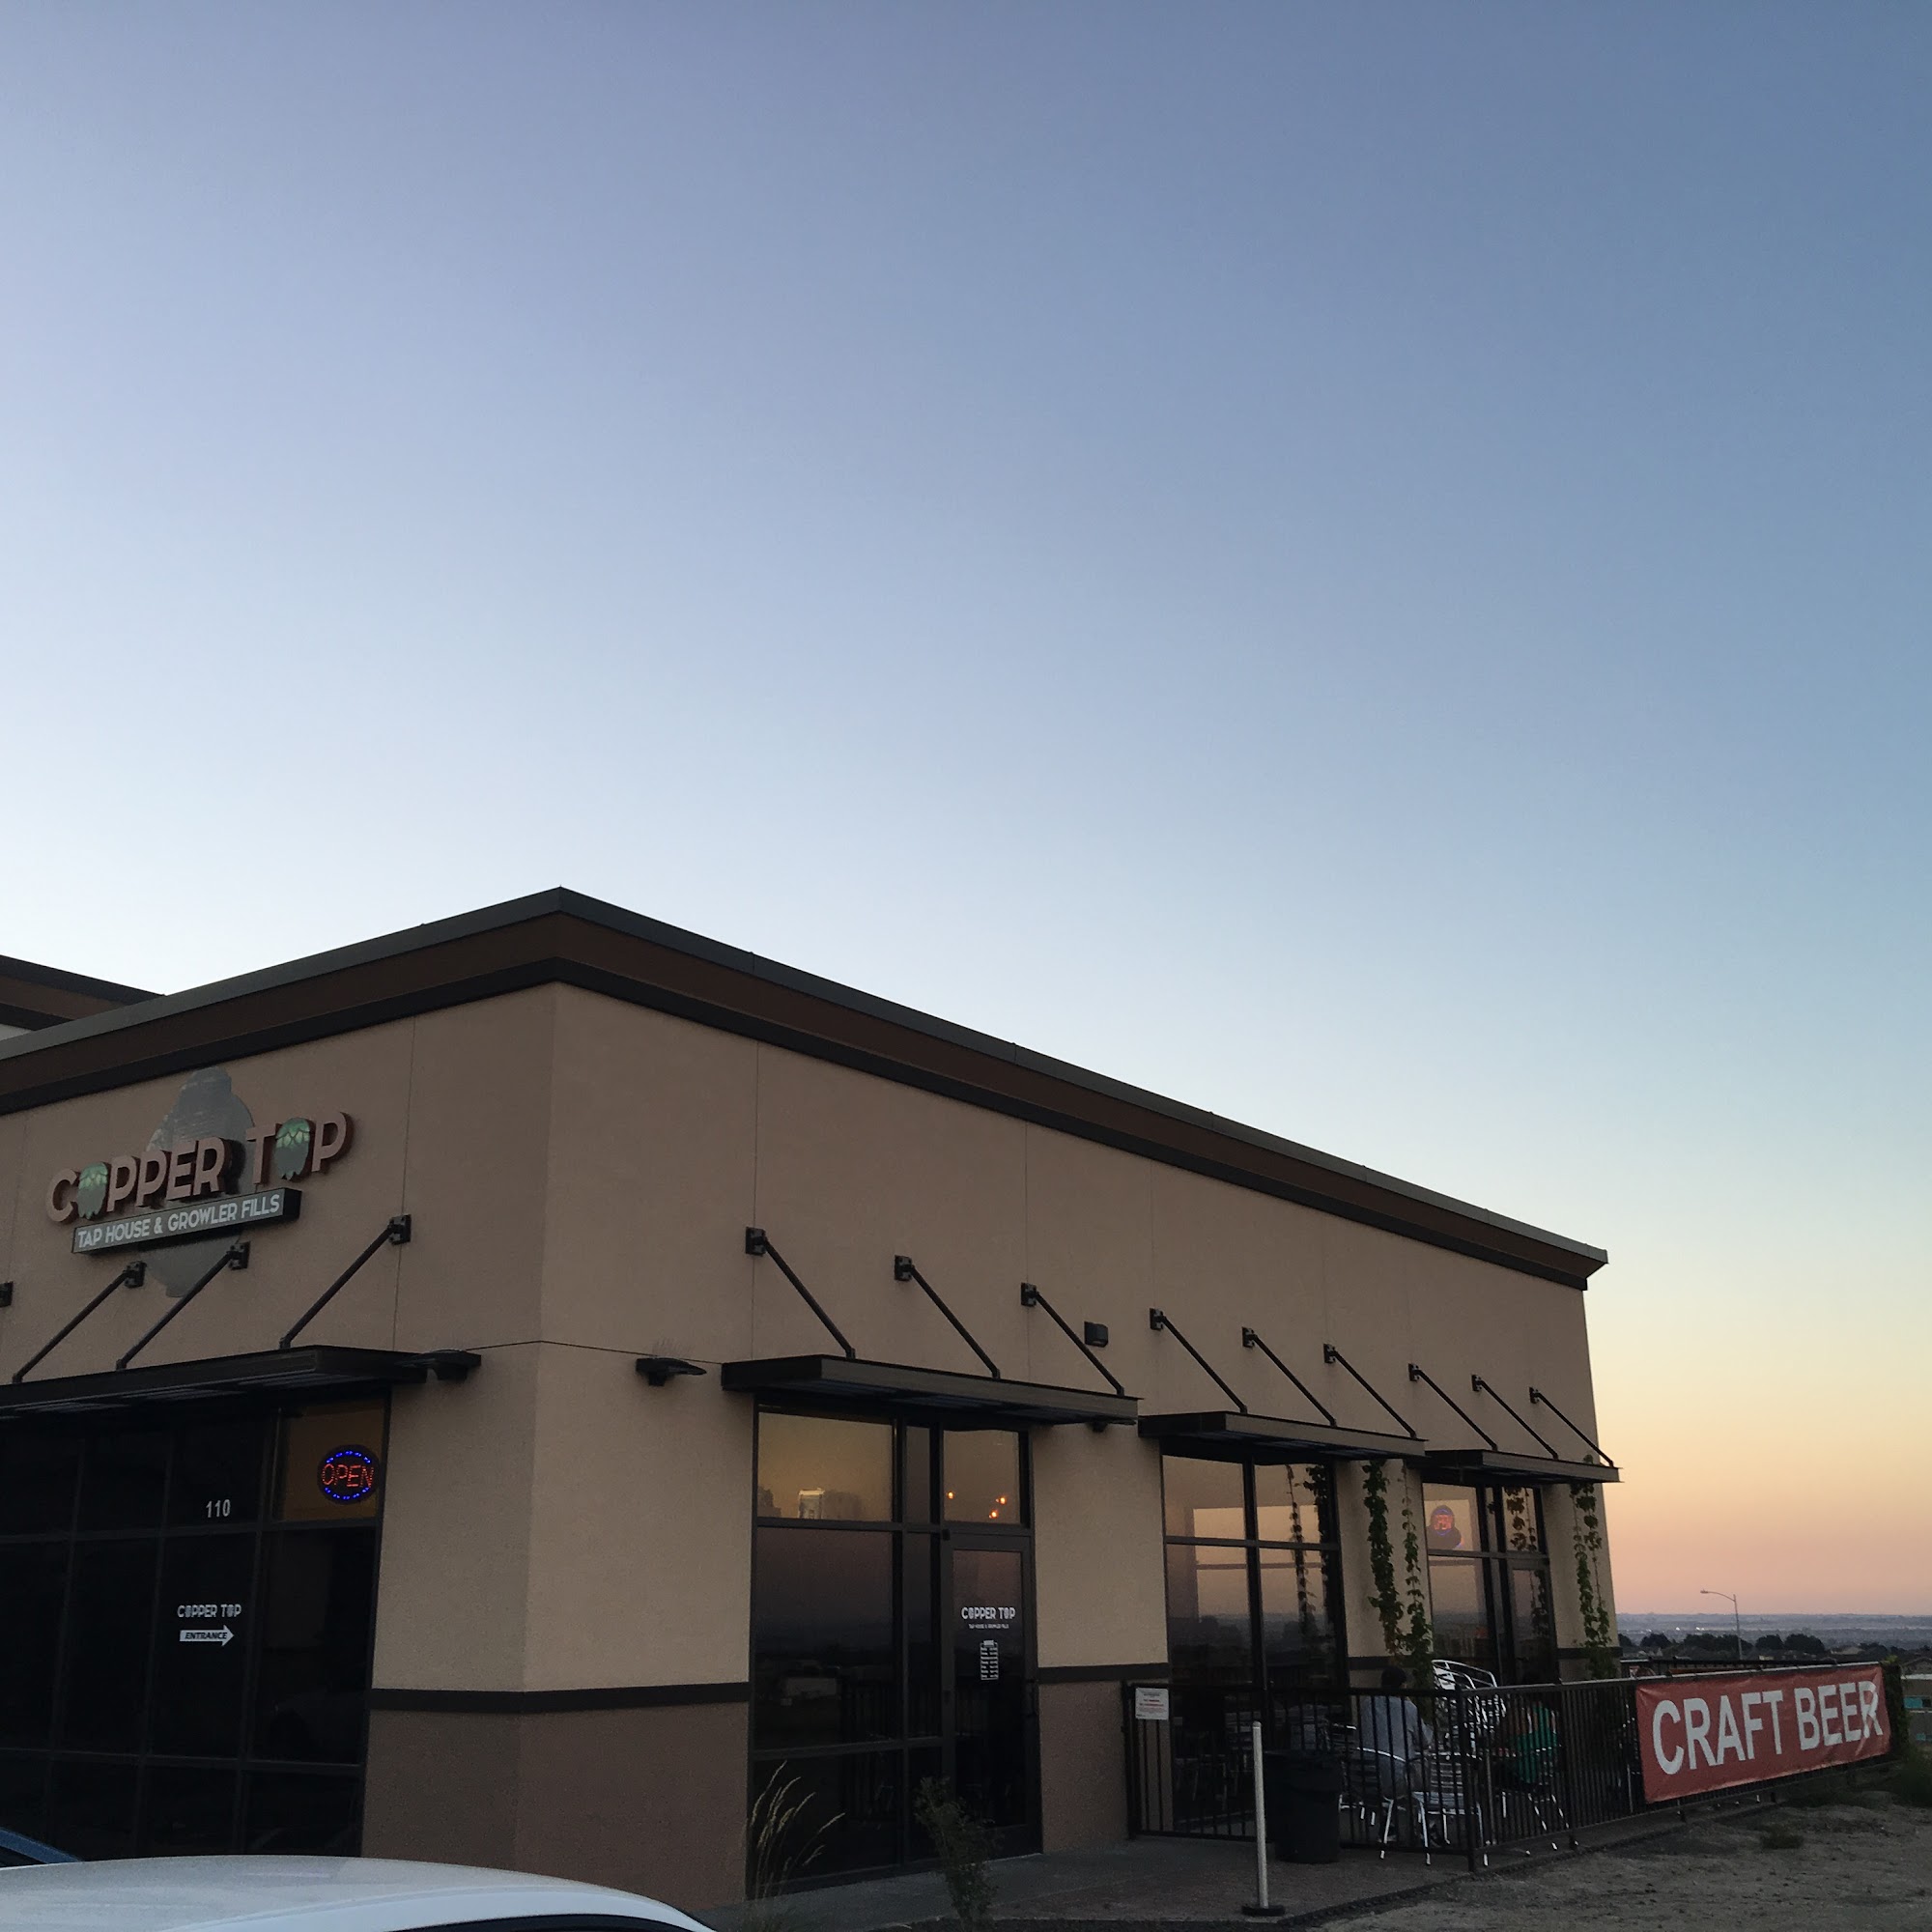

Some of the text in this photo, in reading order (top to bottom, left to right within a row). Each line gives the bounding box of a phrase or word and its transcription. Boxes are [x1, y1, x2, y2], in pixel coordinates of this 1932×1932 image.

[47, 1111, 350, 1223] COPPER TOP
[77, 1194, 280, 1249] TAP HOUSE & GROWLER FILLS
[321, 1463, 375, 1489] OPEN
[205, 1498, 231, 1519] 110
[177, 1604, 242, 1619] COPPER TOP
[961, 1606, 1016, 1620] COPPER TOP
[184, 1631, 229, 1641] ENTRANCE
[1652, 1680, 1884, 1776] CRAFT BEER
